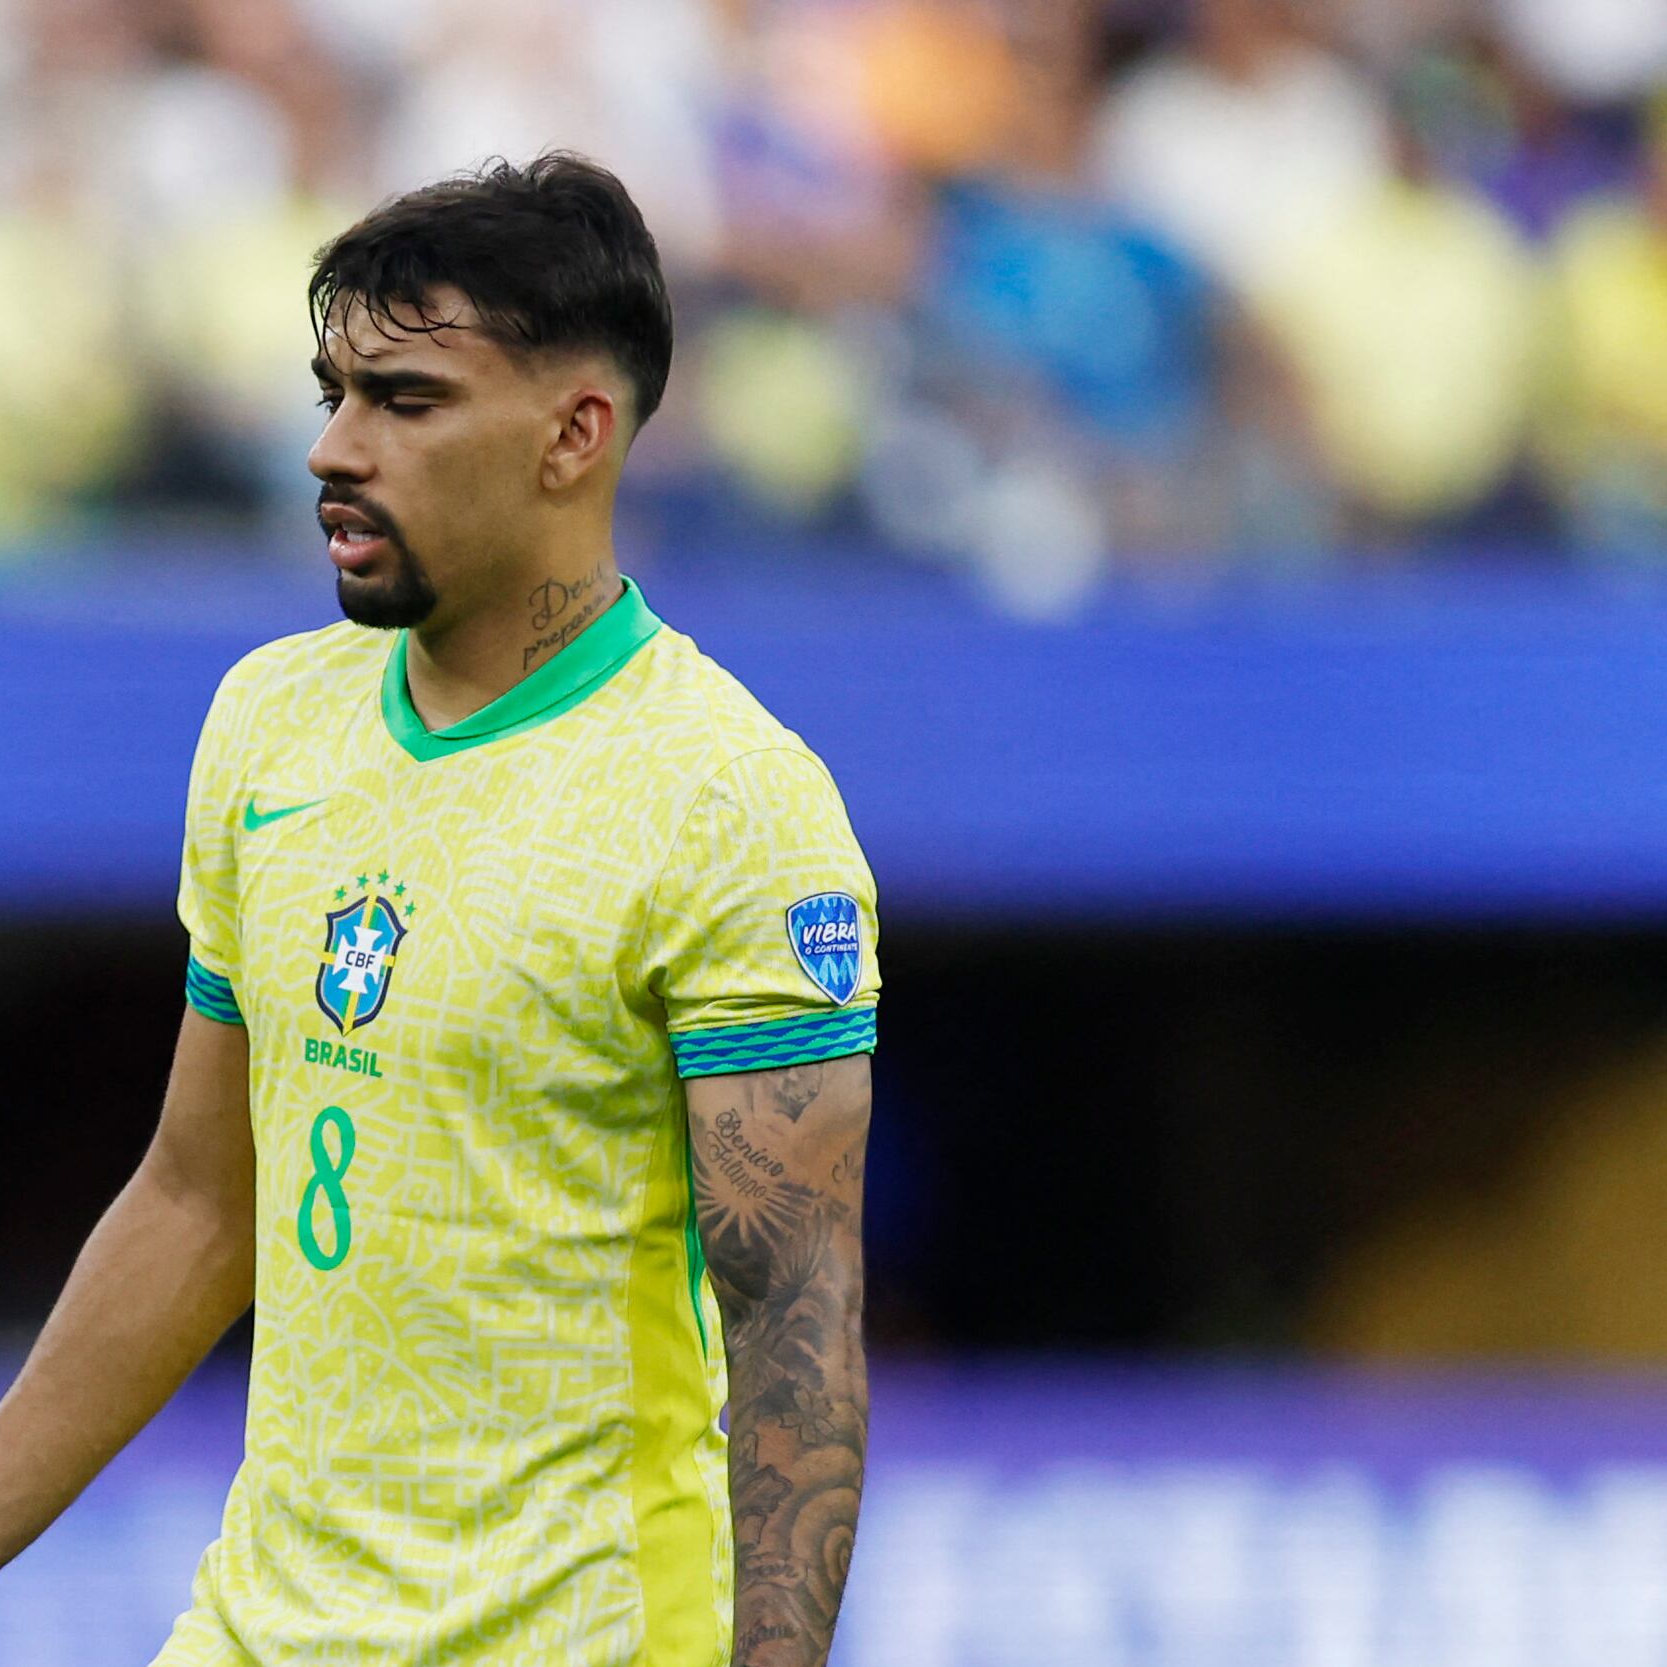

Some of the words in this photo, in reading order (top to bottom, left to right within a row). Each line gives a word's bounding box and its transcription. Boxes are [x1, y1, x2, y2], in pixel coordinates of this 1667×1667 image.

[802, 921, 857, 945] VIBRA
[344, 949, 376, 970] CBF
[804, 945, 812, 956] O
[303, 1037, 383, 1079] BRASIL
[297, 1105, 356, 1272] 8
